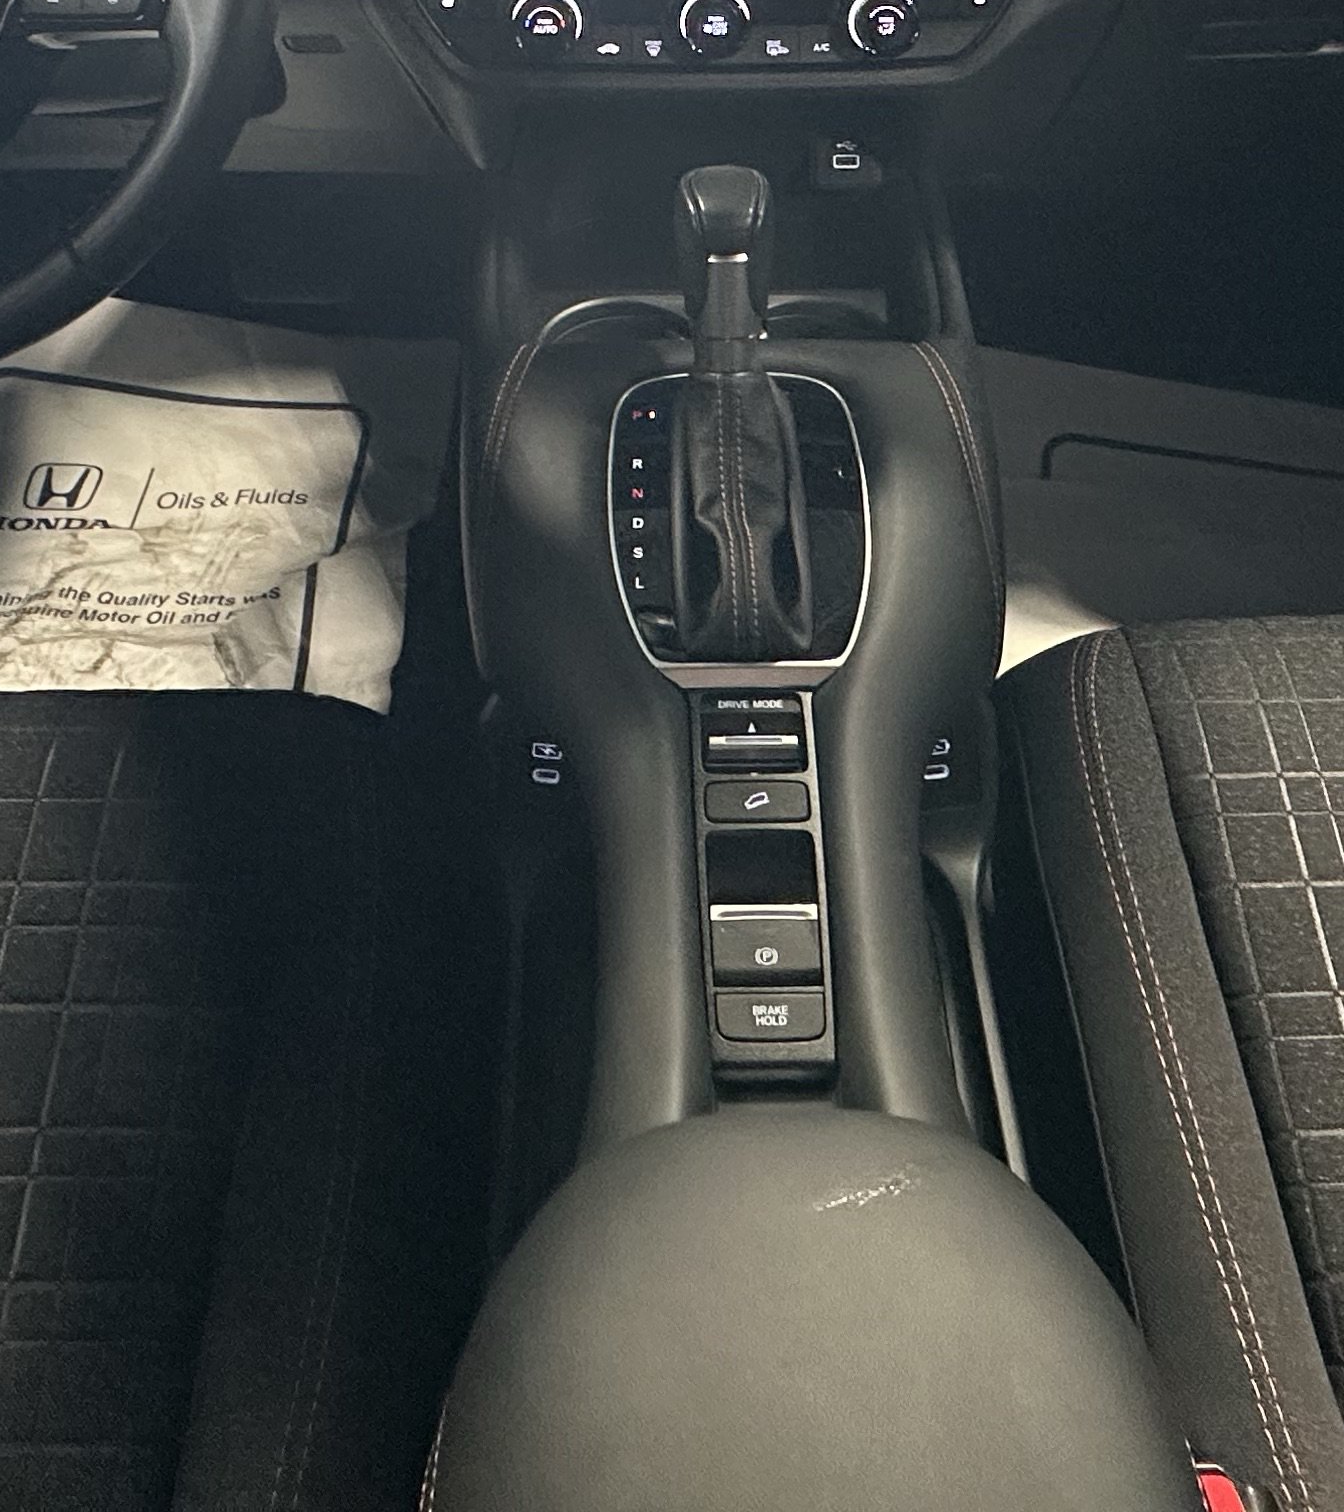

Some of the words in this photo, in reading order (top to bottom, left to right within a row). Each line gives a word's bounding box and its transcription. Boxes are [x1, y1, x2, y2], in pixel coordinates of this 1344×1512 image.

[533, 25, 558, 35] AUTO
[812, 42, 830, 52] A/C
[632, 458, 643, 469] R
[156, 492, 205, 510] Oils
[210, 492, 229, 507] &
[234, 488, 309, 506] Fluids
[632, 488, 644, 499] N
[632, 518, 644, 529] D
[633, 547, 644, 559] S
[635, 577, 644, 589] L
[58, 586, 92, 603] the
[97, 590, 170, 607] Quality
[176, 591, 236, 606] Starts
[78, 609, 140, 625] Motor
[146, 610, 176, 625] Oil
[180, 611, 221, 625] and
[717, 700, 750, 709] DRIVE
[752, 699, 784, 709] MODE
[752, 1005, 788, 1016] BRAKE
[755, 1015, 788, 1027] HOLD
